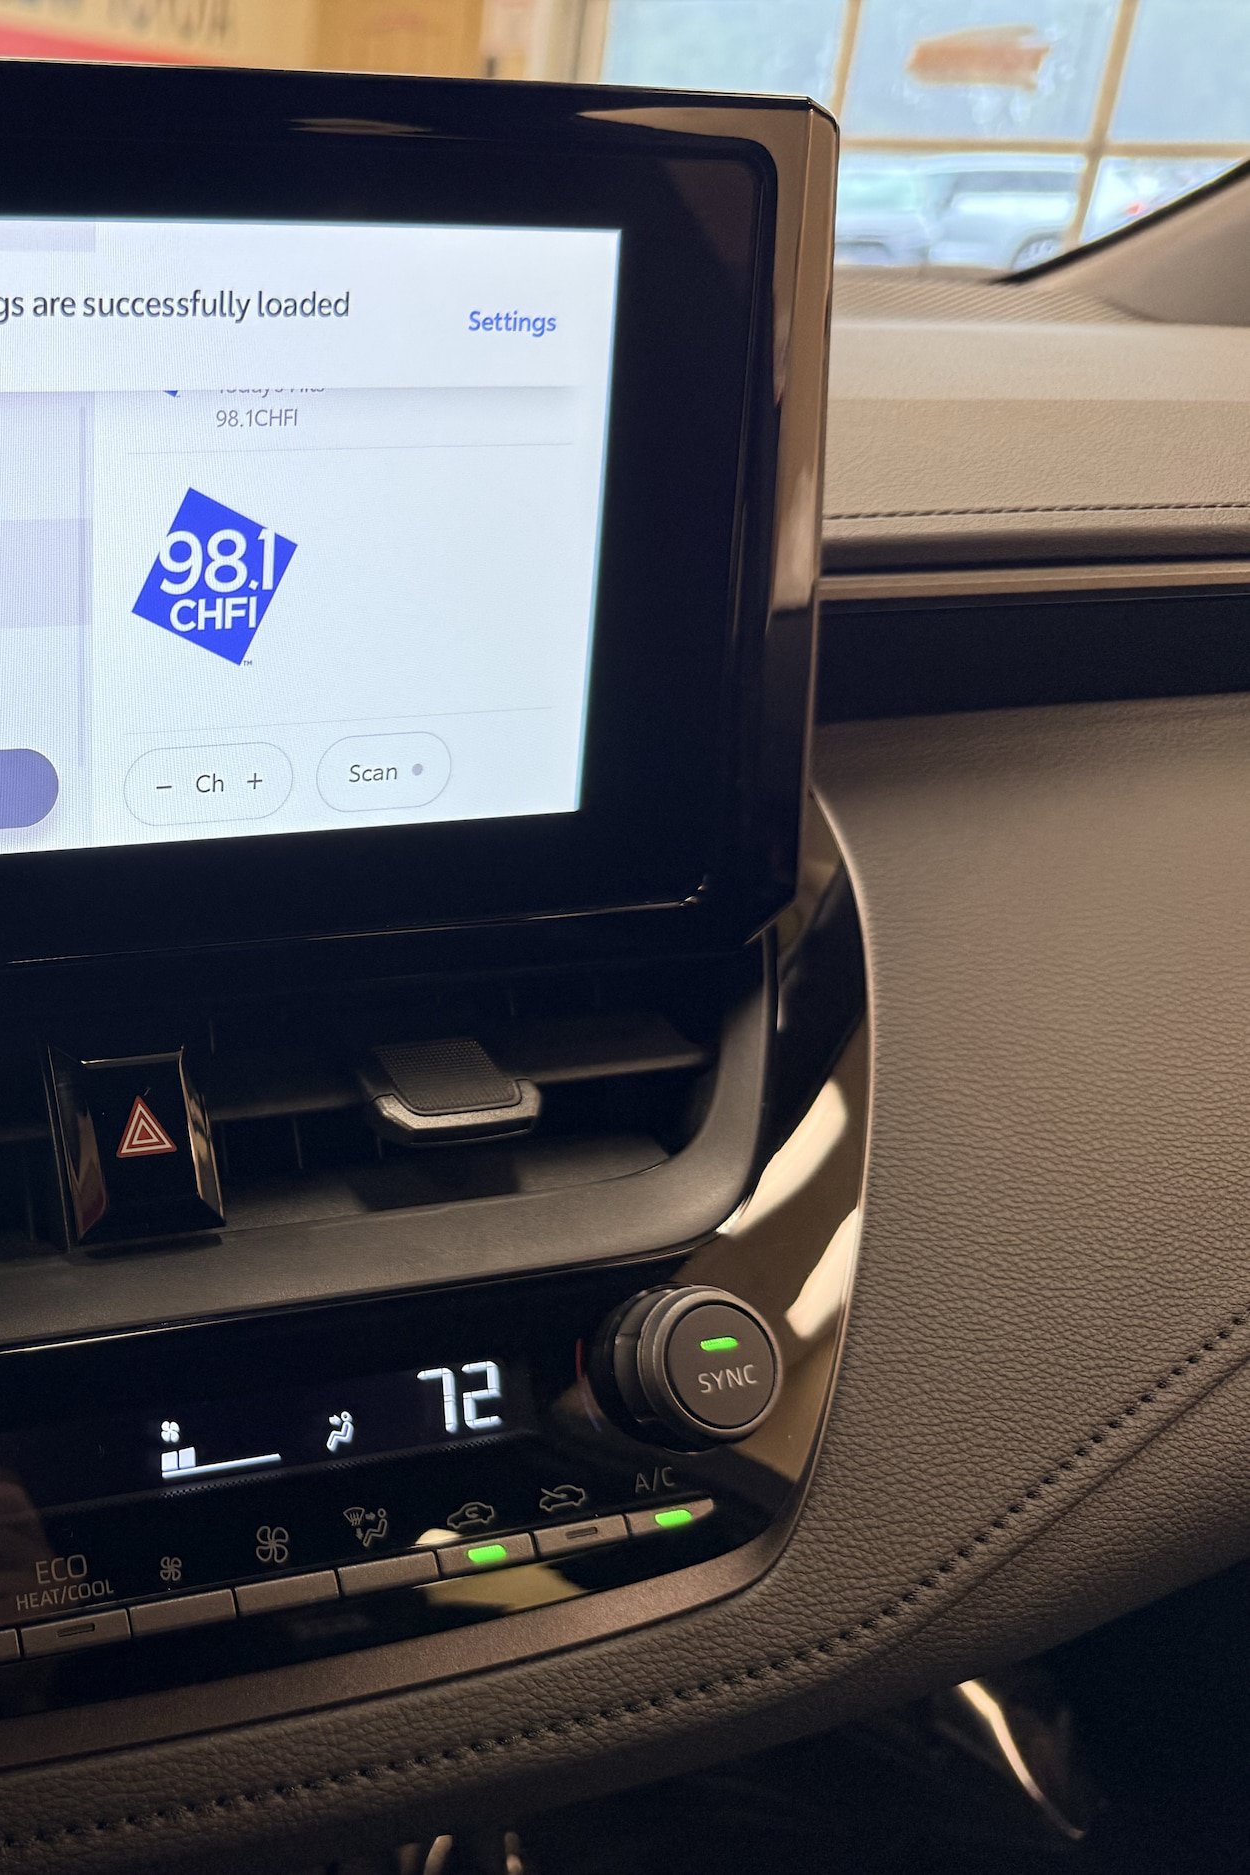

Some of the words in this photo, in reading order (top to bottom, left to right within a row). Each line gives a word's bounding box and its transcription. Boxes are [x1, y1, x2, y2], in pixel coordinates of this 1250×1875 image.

[33, 296, 76, 318] are
[83, 289, 251, 324] successfully
[257, 290, 350, 318] loaded
[467, 310, 557, 338] Settings
[215, 408, 299, 428] 98.1CHFI
[159, 527, 276, 595] 98.1
[169, 596, 257, 633] CHFI
[195, 773, 225, 793] Ch
[348, 763, 398, 783] Scan
[698, 1363, 759, 1393] SYNC
[417, 1360, 503, 1433] 72
[634, 1466, 676, 1493] A/C
[35, 1554, 88, 1585] ECO
[16, 1578, 115, 1612] HEAT/COOL
